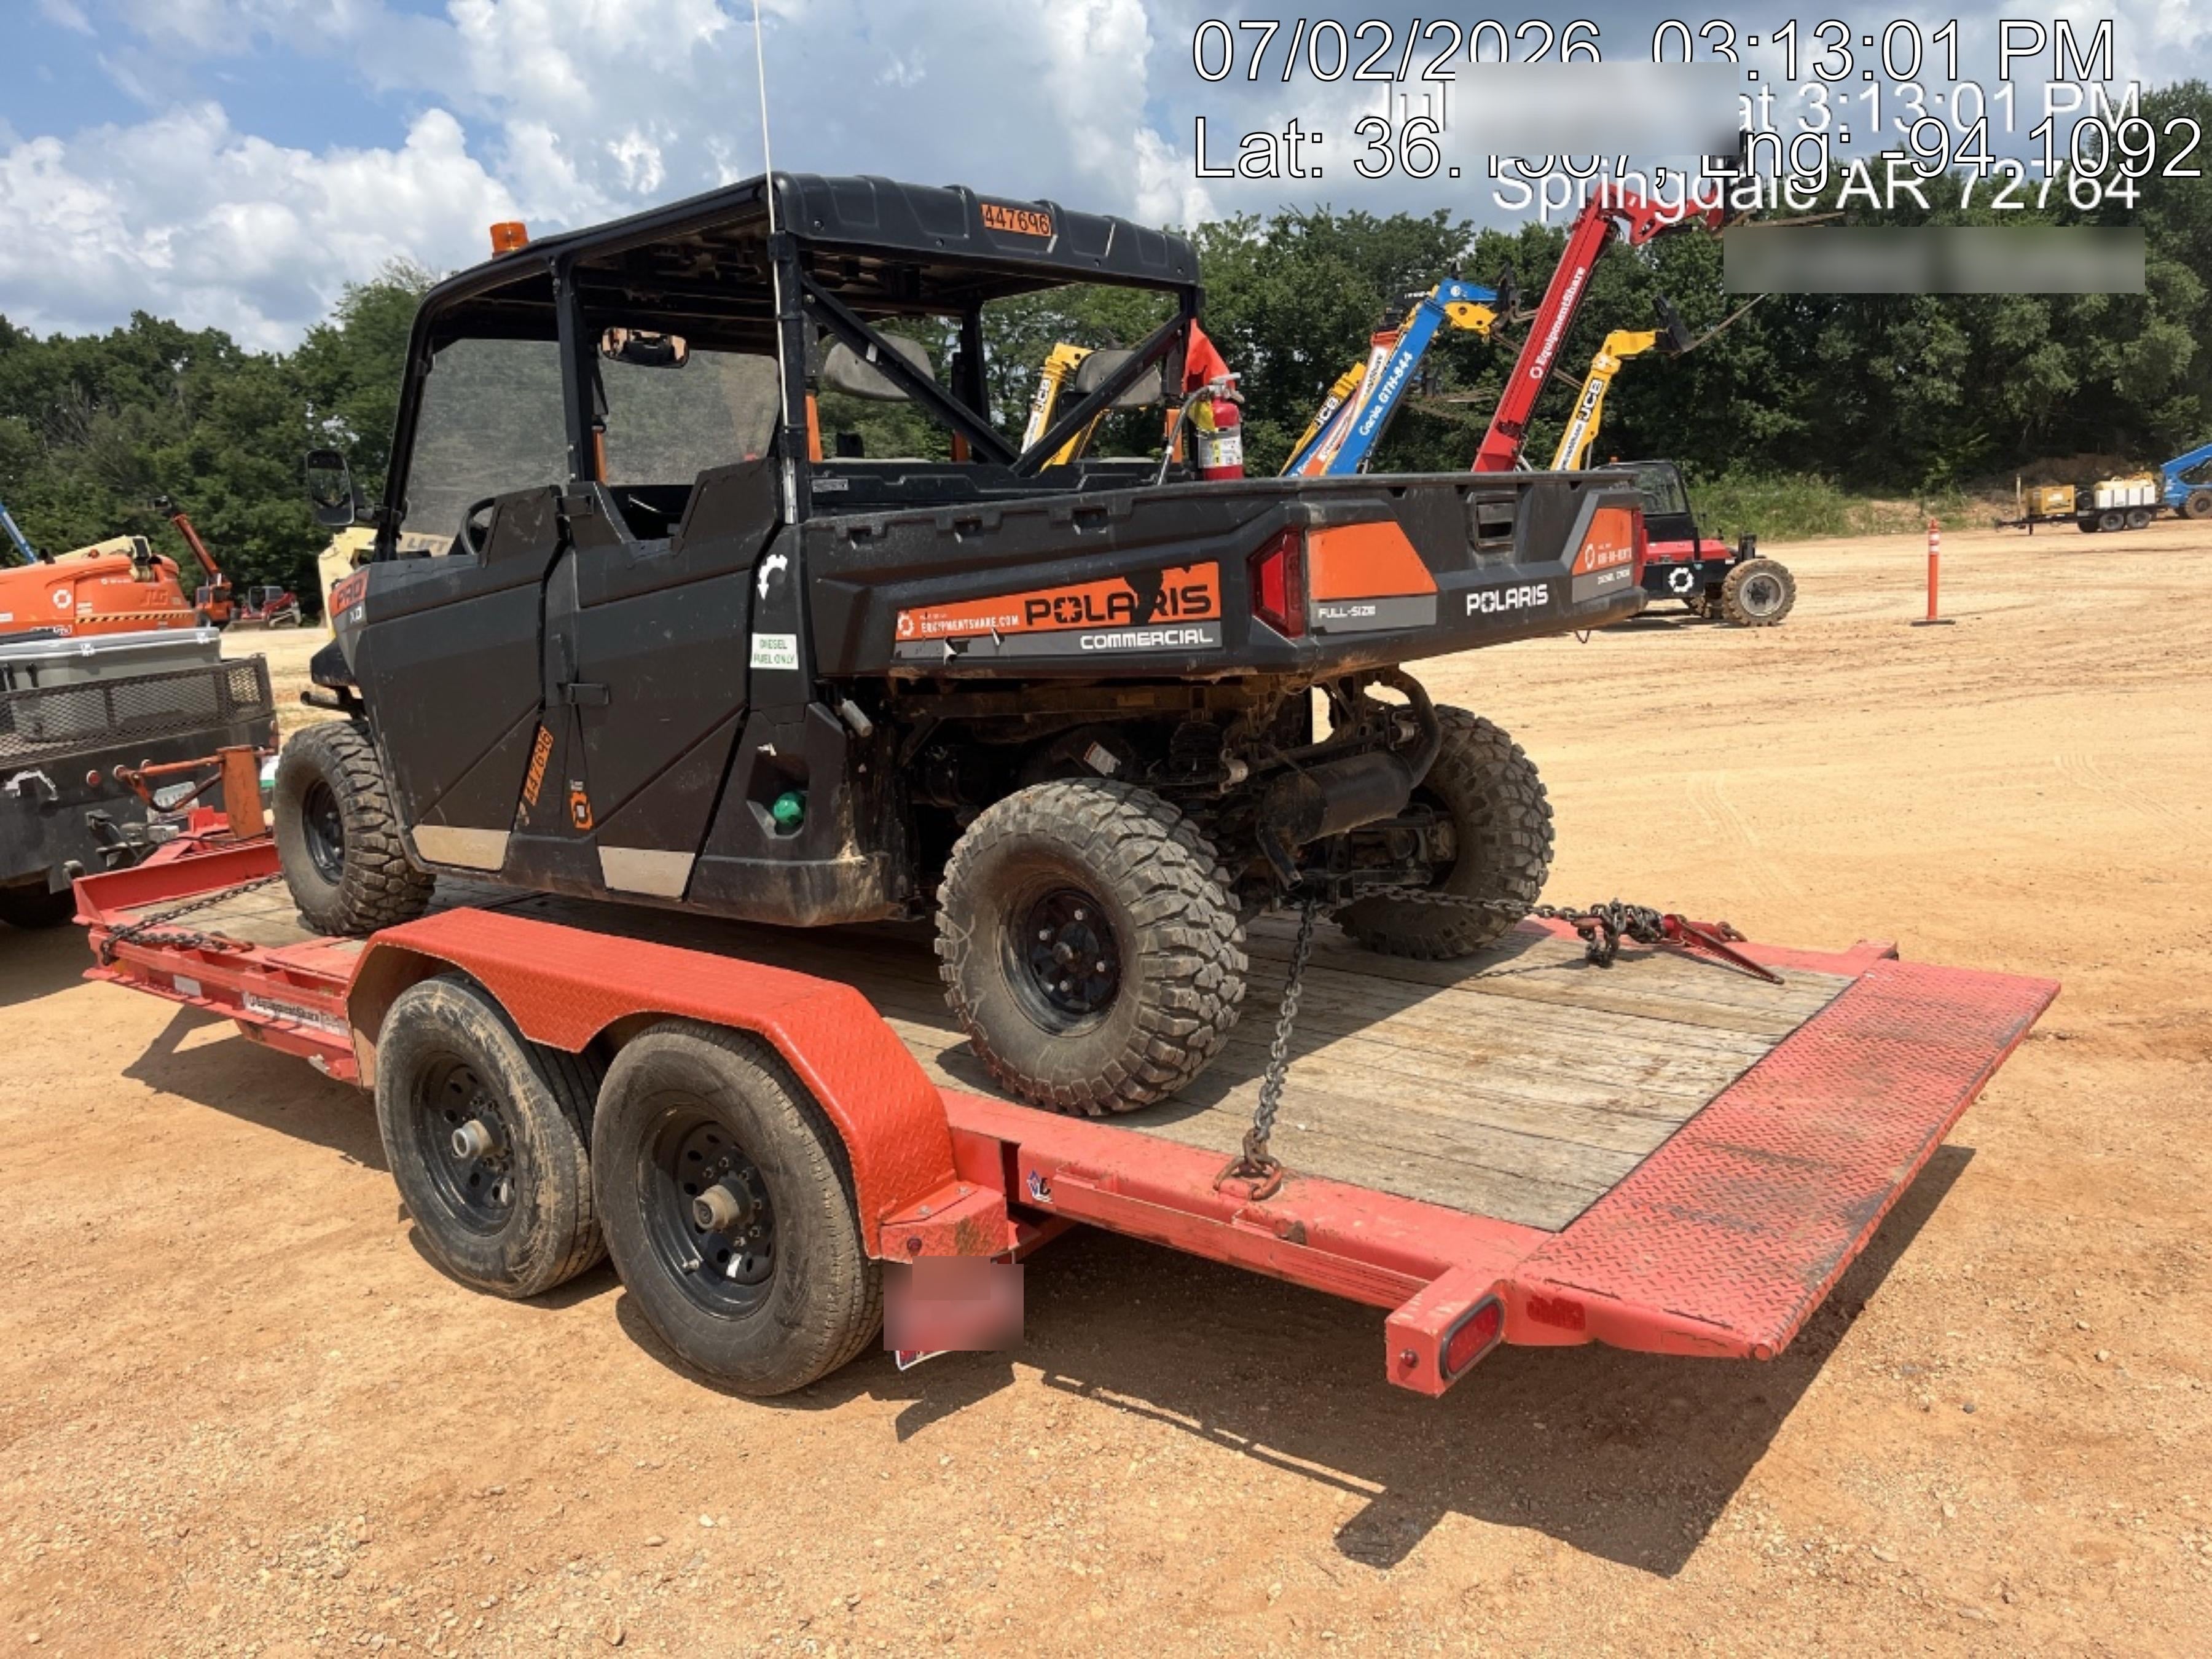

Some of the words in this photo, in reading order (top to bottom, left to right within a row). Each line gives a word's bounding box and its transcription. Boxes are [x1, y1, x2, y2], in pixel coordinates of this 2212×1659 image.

[985, 205, 1050, 235] 447696
[1536, 267, 1586, 365] EquipmentShare
[1359, 404, 1384, 436] Genie
[1378, 351, 1413, 403] GTH-844
[1577, 378, 1603, 422] JCB
[1316, 396, 1339, 428] JCB
[407, 537, 449, 552] LIFT
[140, 589, 168, 607] JLG
[1024, 584, 1212, 626] POLARIS
[1467, 584, 1549, 616] POLARIS
[921, 614, 1019, 633] EQUIPMENTSHARE.COM
[1317, 605, 1376, 619] FULL-SIZE
[759, 639, 788, 649] DIESEL
[1080, 628, 1214, 649] COMMERCIAL
[753, 653, 772, 664] FUEL
[774, 654, 794, 665] ONLY
